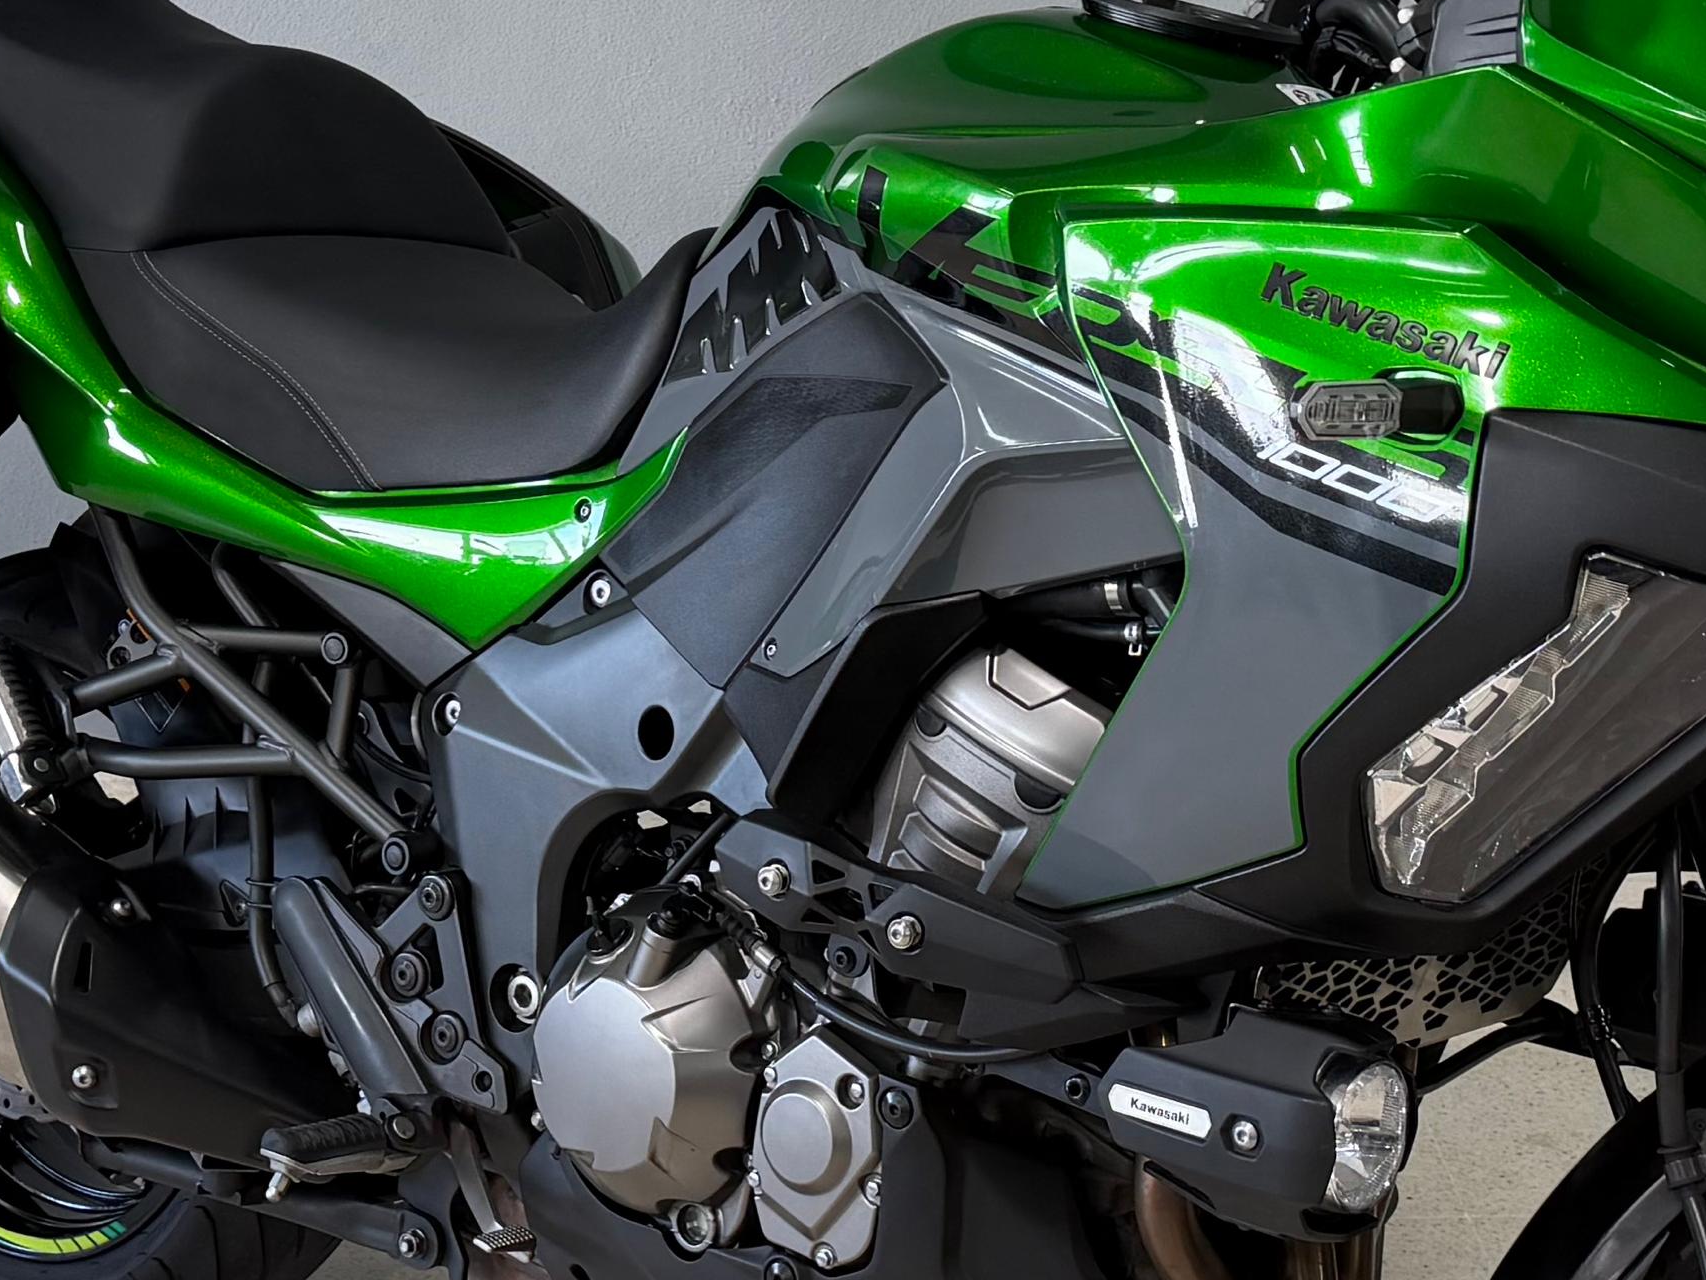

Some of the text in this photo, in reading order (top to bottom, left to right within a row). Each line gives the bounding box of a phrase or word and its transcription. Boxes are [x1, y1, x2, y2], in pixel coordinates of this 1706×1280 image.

[1260, 262, 1512, 380] Kawasaki
[1255, 439, 1445, 523] 1000
[1130, 1096, 1190, 1125] Kawasaki
